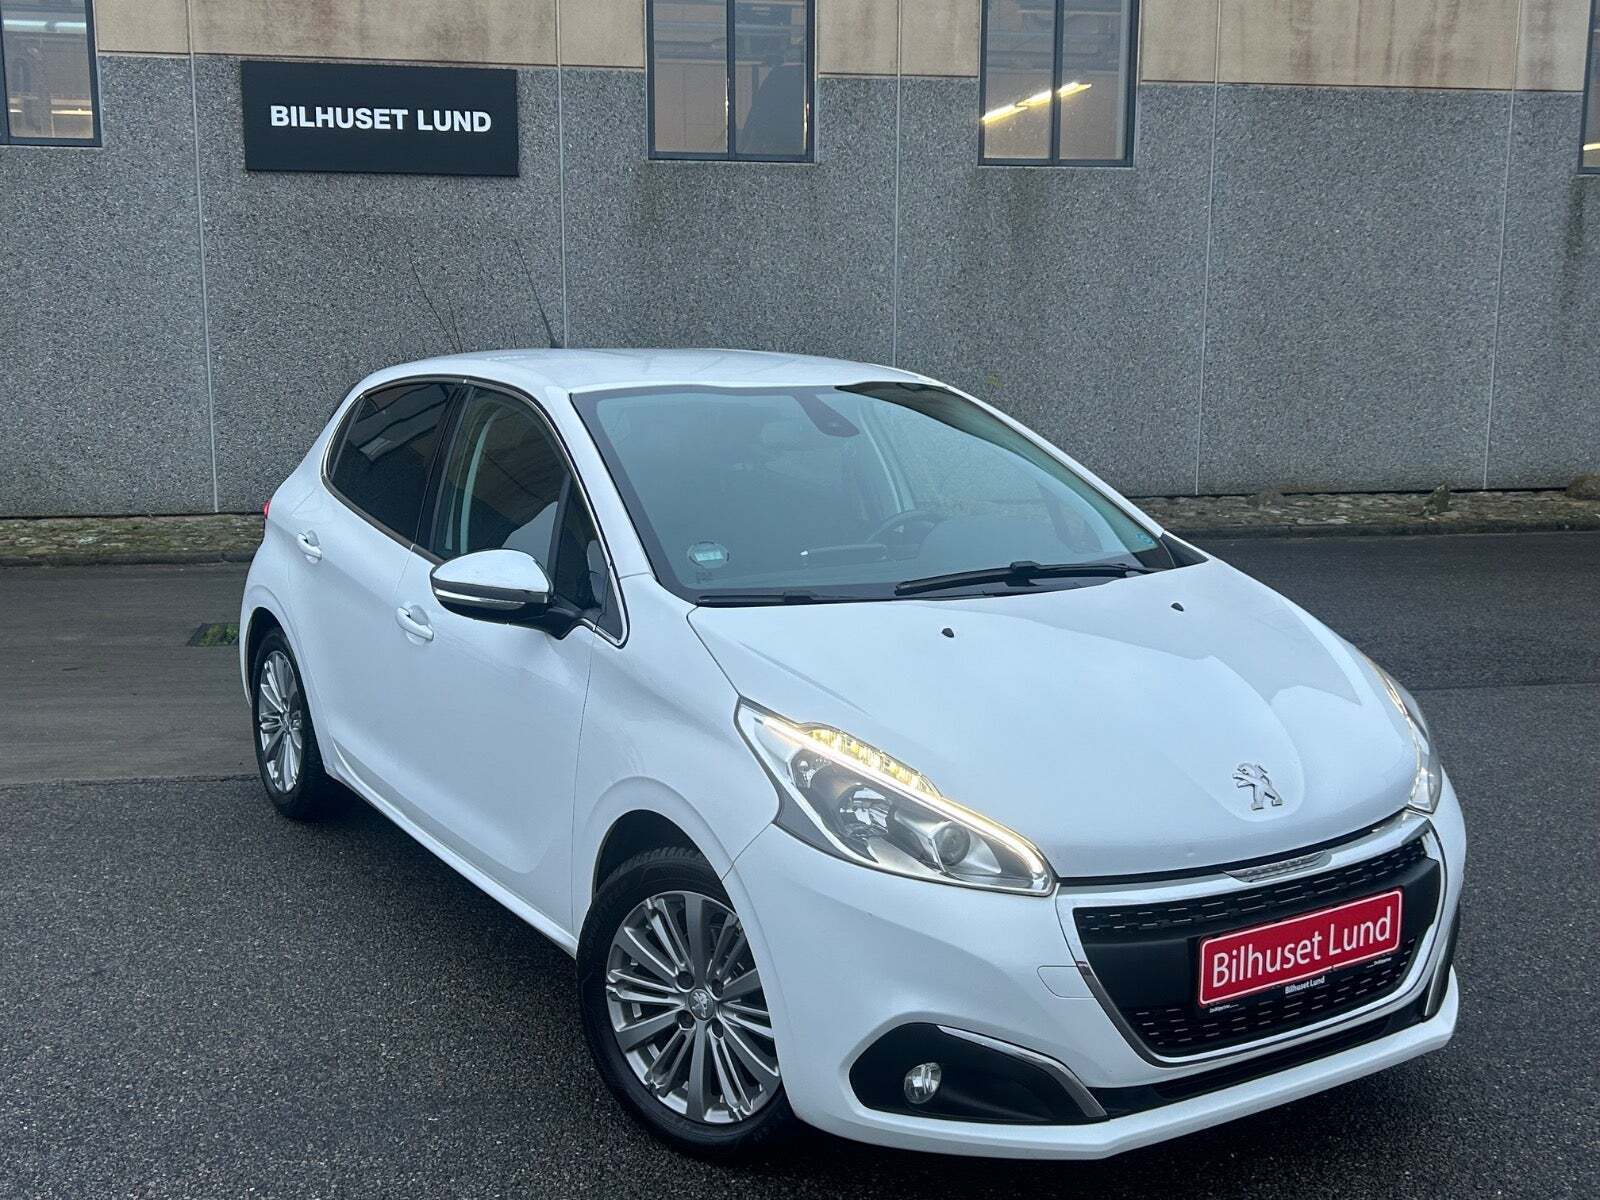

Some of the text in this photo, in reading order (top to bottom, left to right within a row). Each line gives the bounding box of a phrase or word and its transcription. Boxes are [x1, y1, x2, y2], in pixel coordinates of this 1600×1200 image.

[270, 105, 491, 132] BILHUSET LUND
[1212, 906, 1391, 987] Bilhuset Lund
[1285, 975, 1325, 994] Bilhuset Lund
